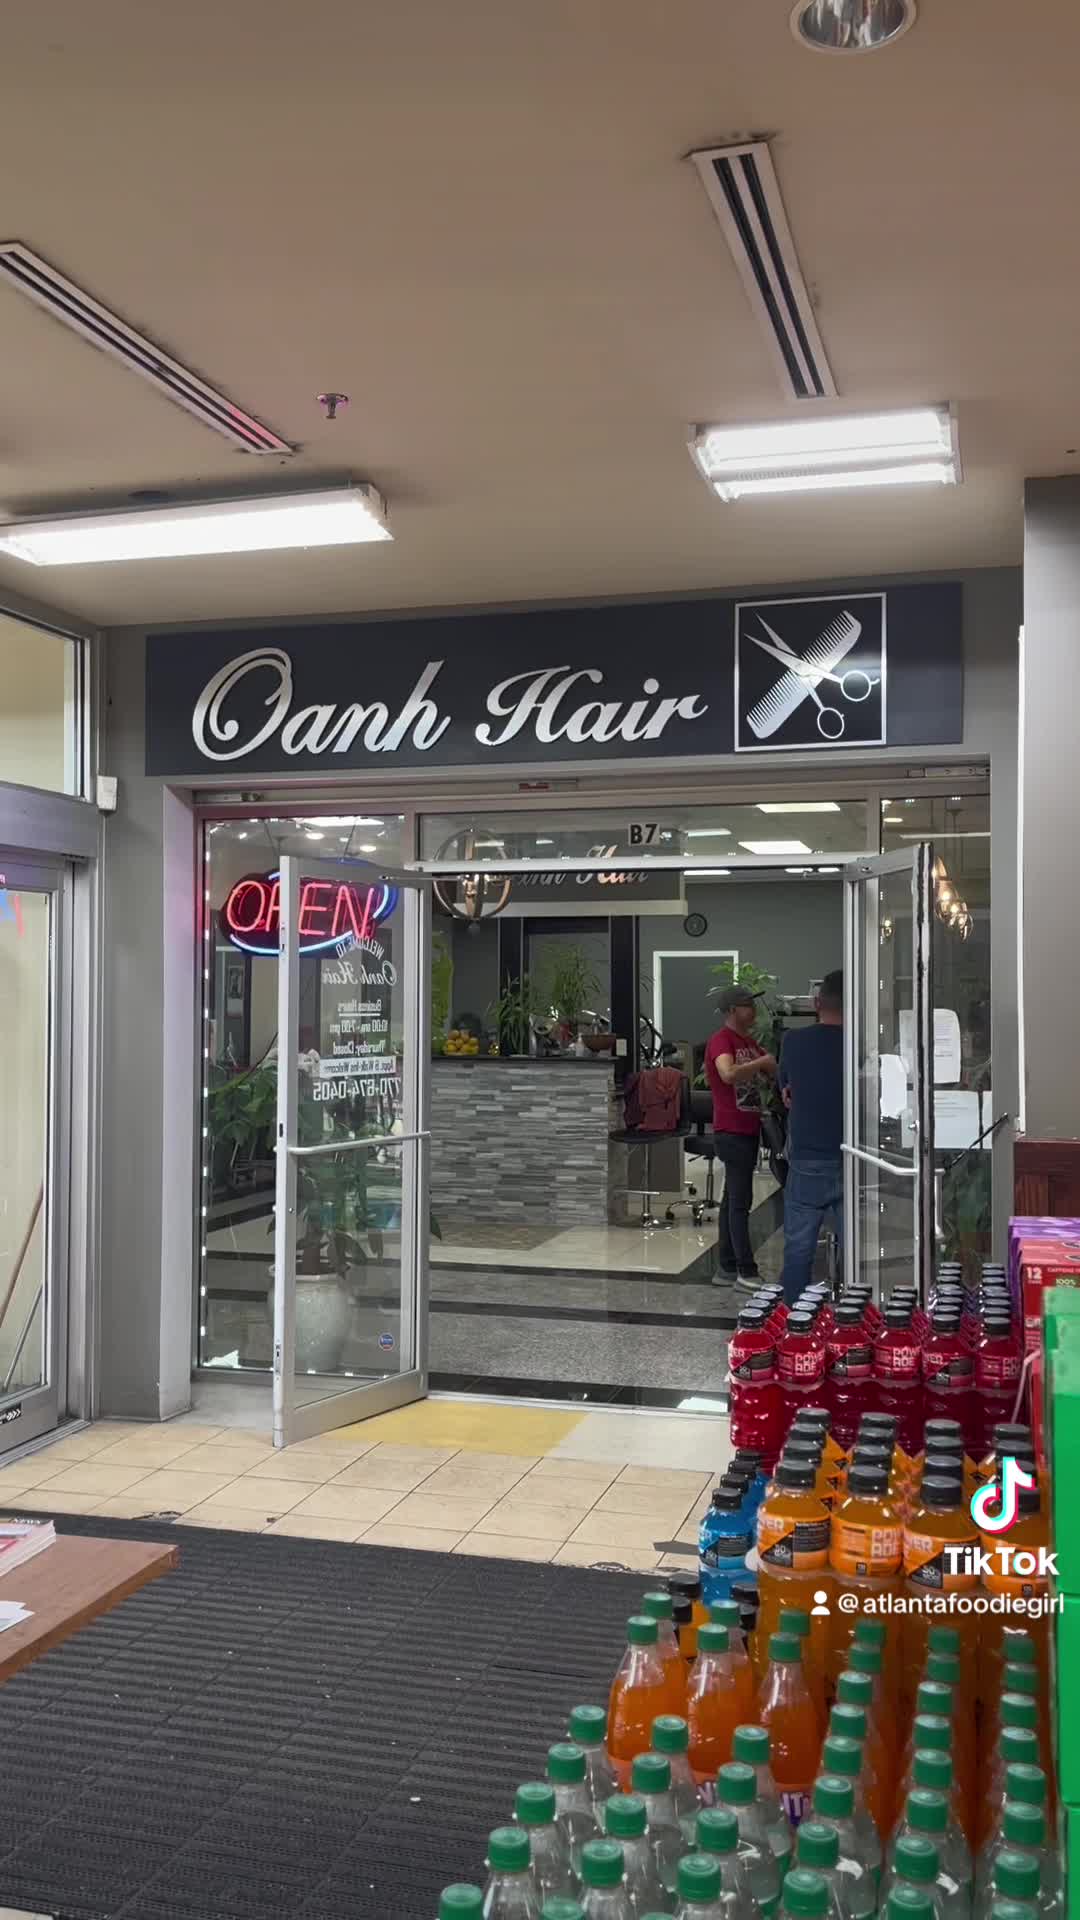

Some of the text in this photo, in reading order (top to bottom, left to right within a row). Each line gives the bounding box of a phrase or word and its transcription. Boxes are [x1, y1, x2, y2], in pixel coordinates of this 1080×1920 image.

[192, 647, 709, 761] Oanh Hair
[629, 823, 657, 845] B7
[226, 880, 375, 938] OPEN
[1027, 1266, 1042, 1279] 12
